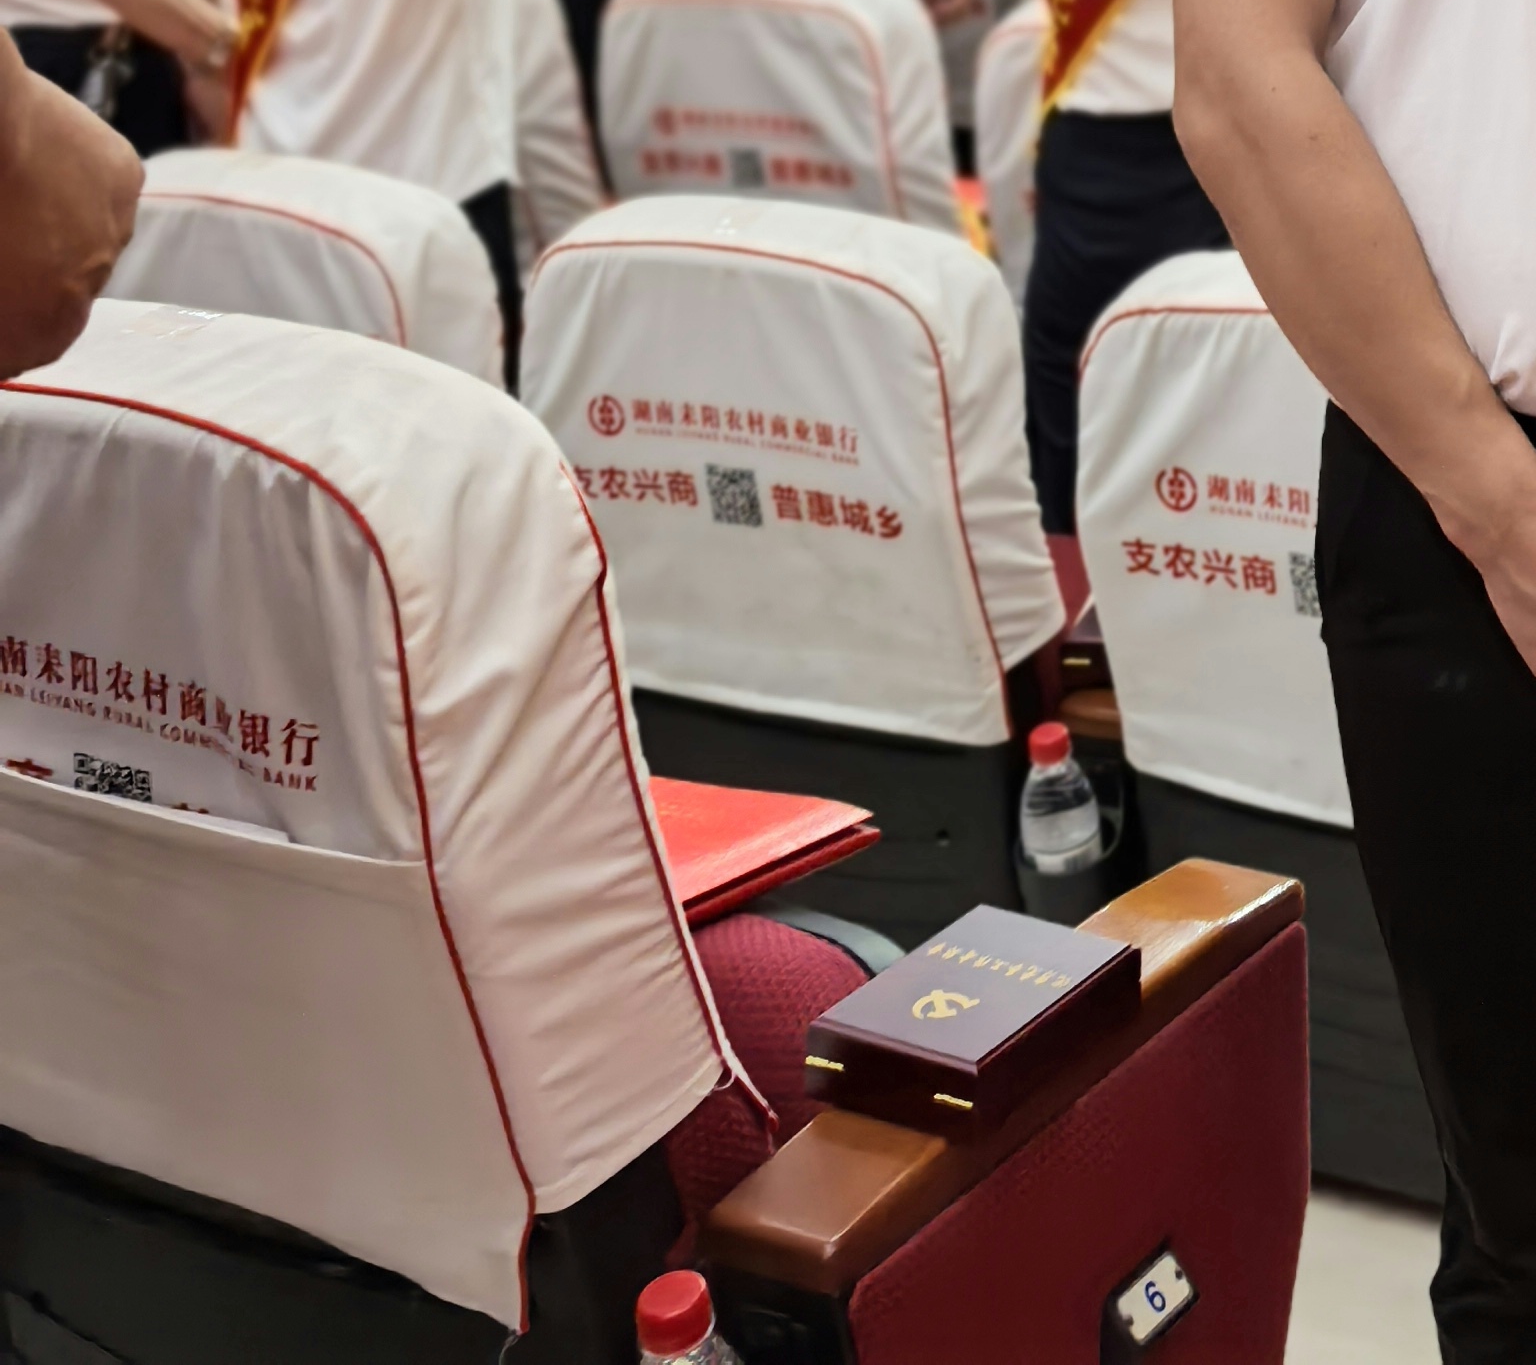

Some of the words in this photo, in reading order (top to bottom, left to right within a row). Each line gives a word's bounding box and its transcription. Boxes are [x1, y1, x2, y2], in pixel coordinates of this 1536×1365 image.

[771, 484, 903, 539] 普惠城乡
[1121, 537, 1278, 595] 支农兴商
[1144, 1280, 1166, 1313] 6
